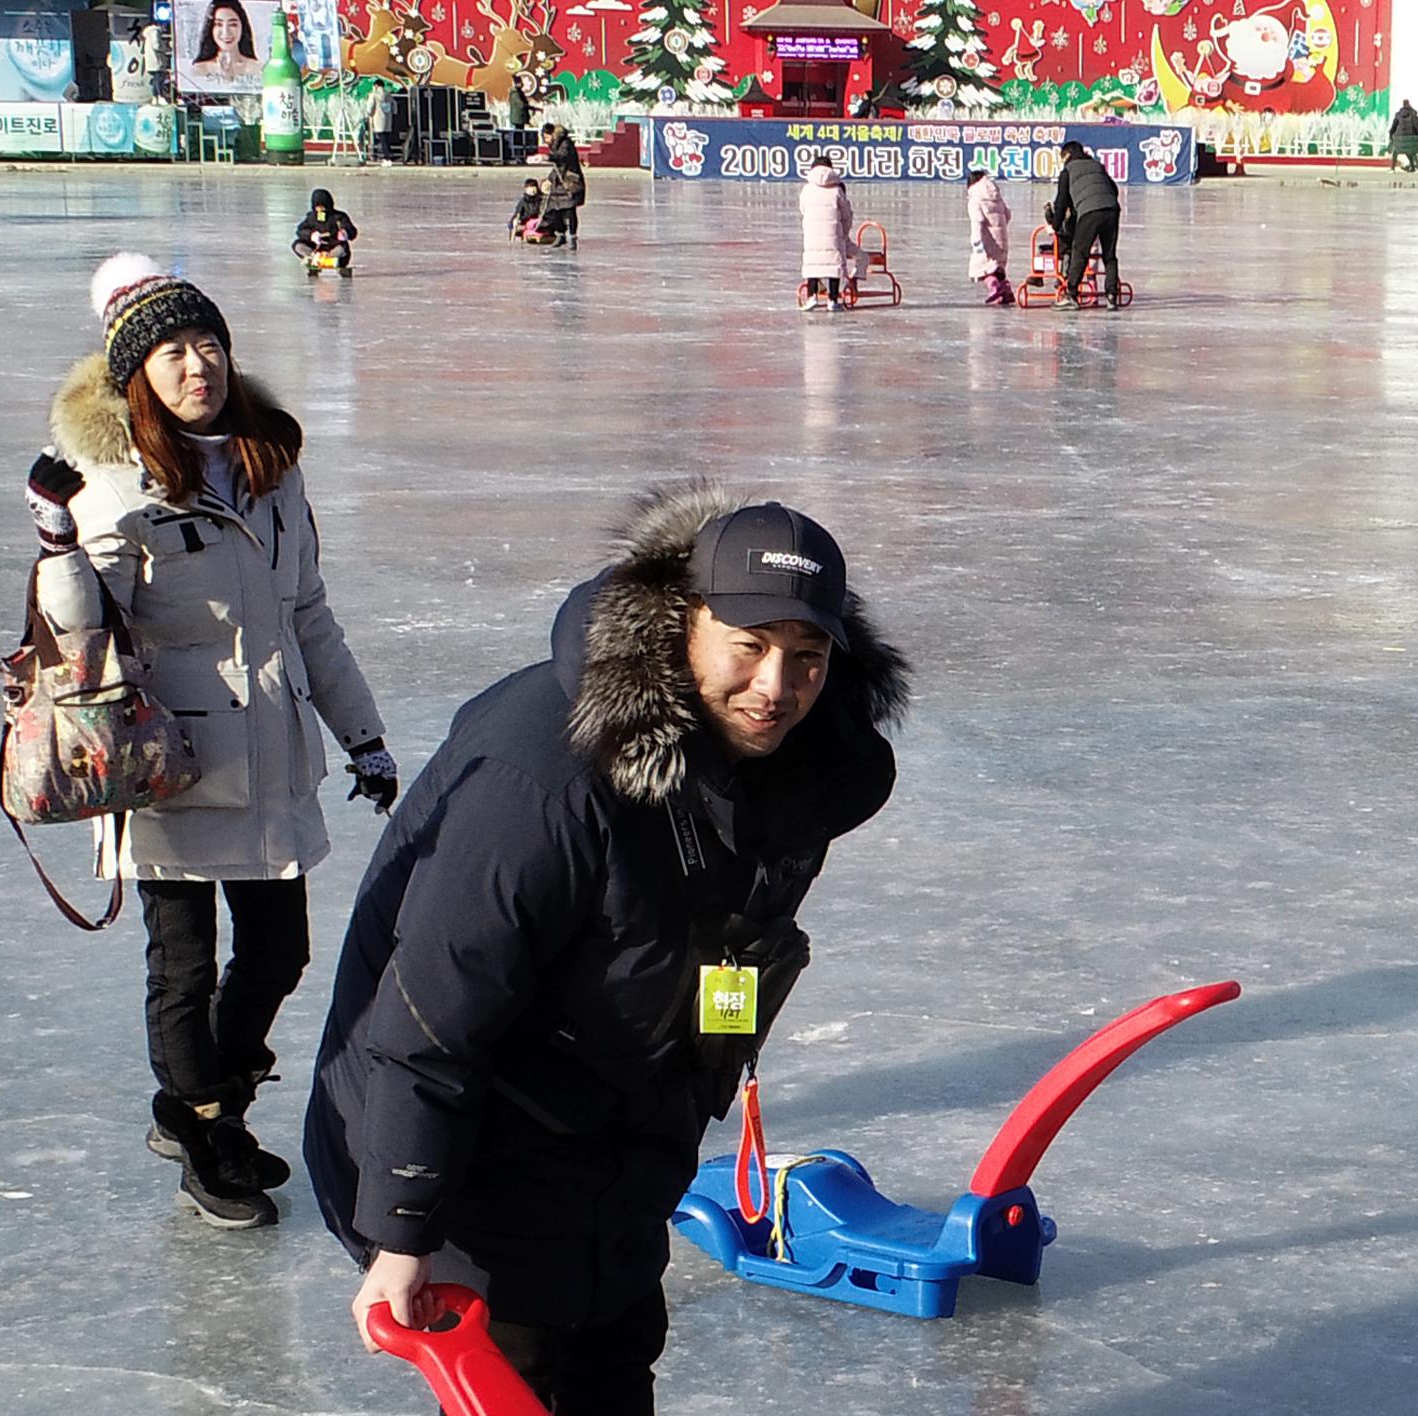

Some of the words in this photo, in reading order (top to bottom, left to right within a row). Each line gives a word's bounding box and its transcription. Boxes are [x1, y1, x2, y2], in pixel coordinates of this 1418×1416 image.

[785, 123, 814, 142] 세계
[817, 123, 840, 141] 4대
[908, 125, 960, 144] 대한민국
[962, 125, 1002, 144] 글로벌
[720, 144, 789, 177] 2019
[794, 144, 902, 178] 얼음나라
[909, 147, 963, 179] 화천
[761, 551, 823, 574] DISCOVERY
[712, 989, 747, 1011] 현장
